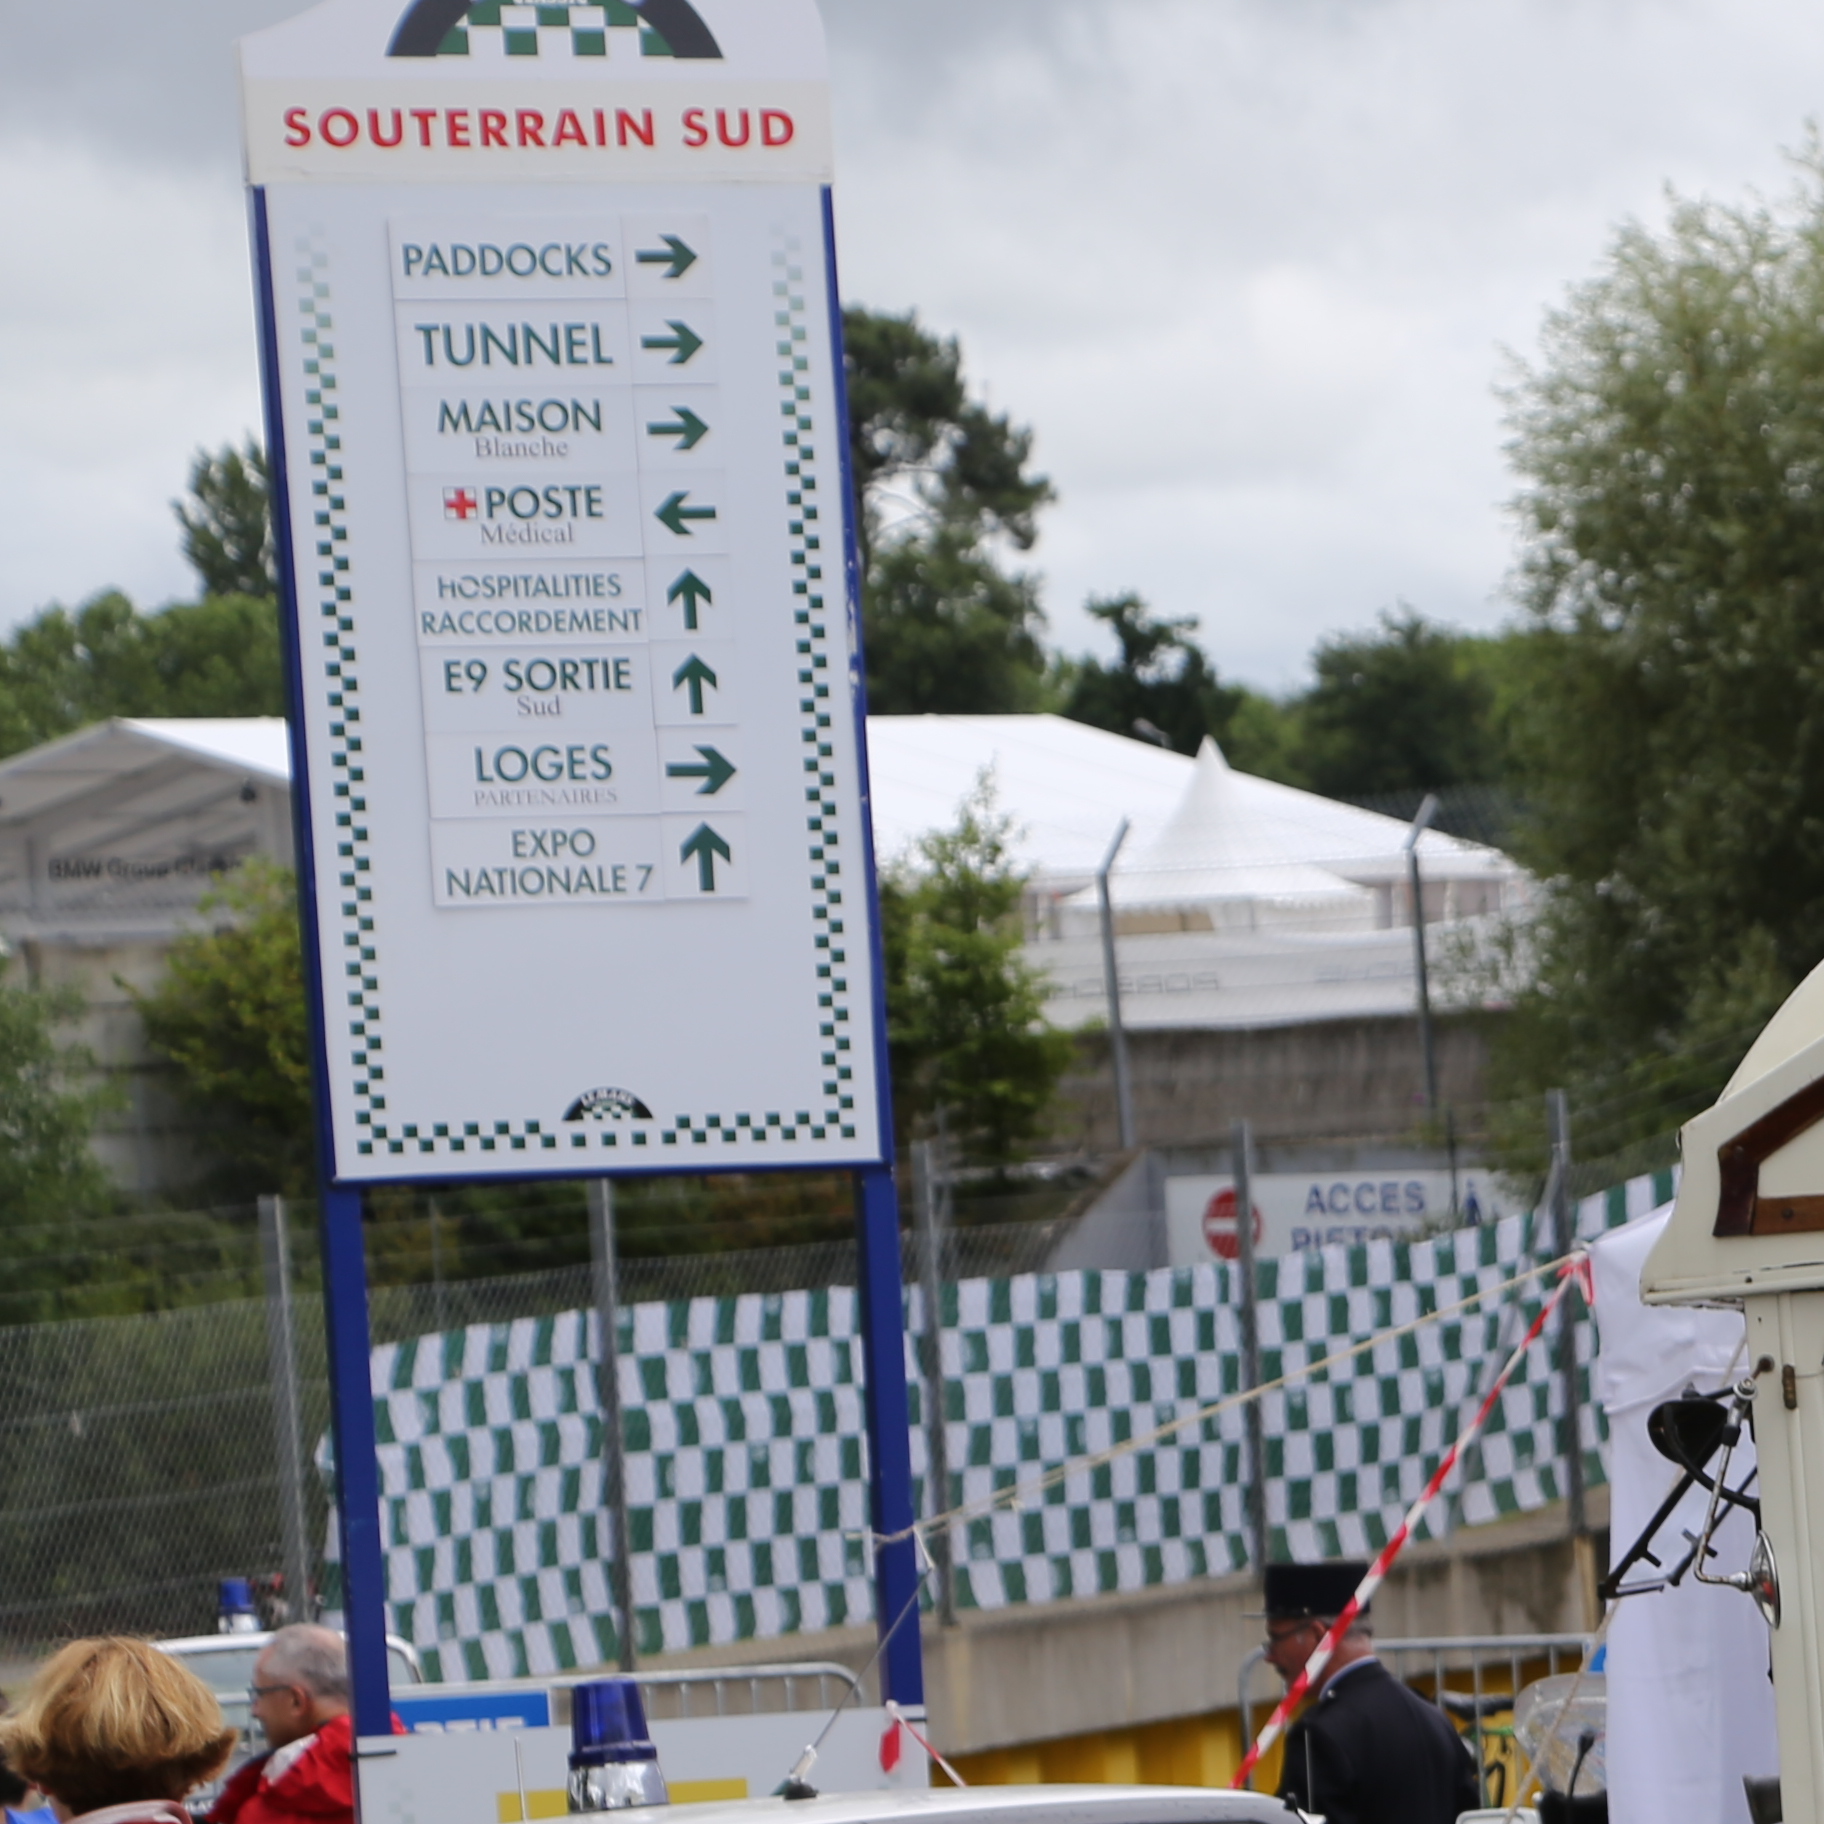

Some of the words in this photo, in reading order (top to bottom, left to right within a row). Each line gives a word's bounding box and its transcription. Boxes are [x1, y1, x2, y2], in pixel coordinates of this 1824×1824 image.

[283, 106, 655, 149] SOUTERRAIN
[681, 107, 795, 149] SUD
[402, 242, 612, 278] PADDOCKS
[414, 322, 613, 366] TUNNEL
[437, 398, 602, 436] MAISON
[474, 435, 568, 459] Blanche
[484, 484, 604, 519] POSTE
[480, 522, 574, 544] Médical
[437, 573, 622, 599] HOSPITALITIES
[421, 607, 643, 635] RACCORDEMENT
[443, 658, 488, 693] E9
[502, 656, 632, 693] SORTIE
[516, 695, 562, 716] Sud
[473, 742, 613, 783] LOGES
[474, 787, 618, 807] PARTENAIRES
[510, 827, 596, 858] EXPO
[445, 864, 627, 897] NATIONALE
[635, 863, 655, 893] 7
[1305, 1181, 1425, 1214] ACCES
